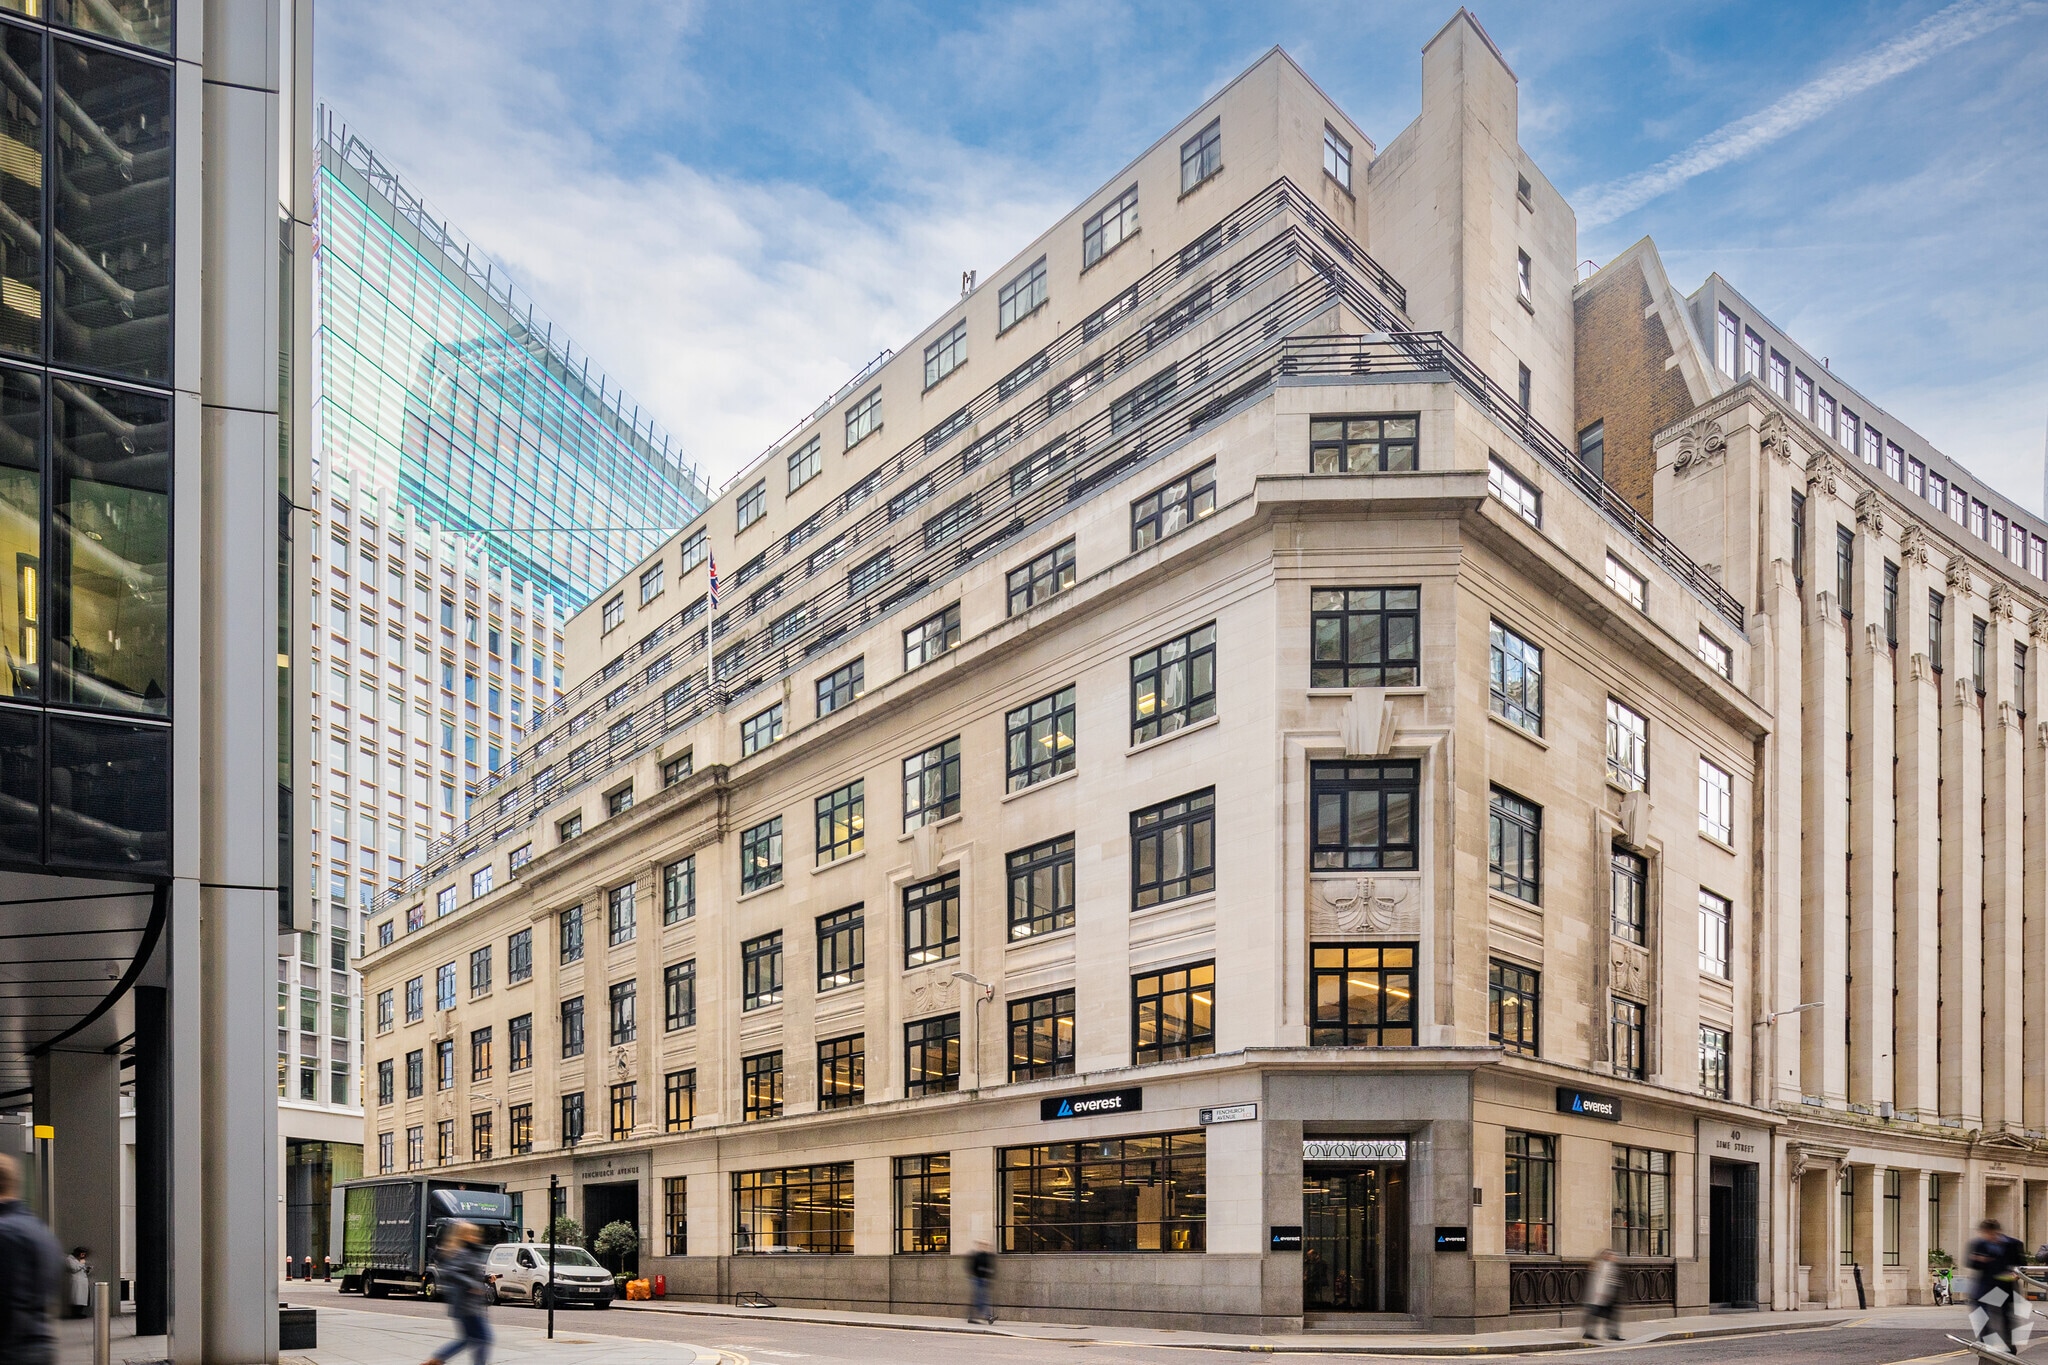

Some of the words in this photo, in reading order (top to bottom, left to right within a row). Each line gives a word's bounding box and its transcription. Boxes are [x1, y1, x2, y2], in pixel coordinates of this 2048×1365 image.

[1074, 1096, 1121, 1112] everest
[1583, 1100, 1612, 1115] everest
[1731, 1130, 1740, 1140] 40
[1716, 1140, 1731, 1150] LIME
[1734, 1143, 1755, 1153] STREET
[582, 1169, 614, 1179] FENCHURCH
[617, 1166, 639, 1175] AVENUE
